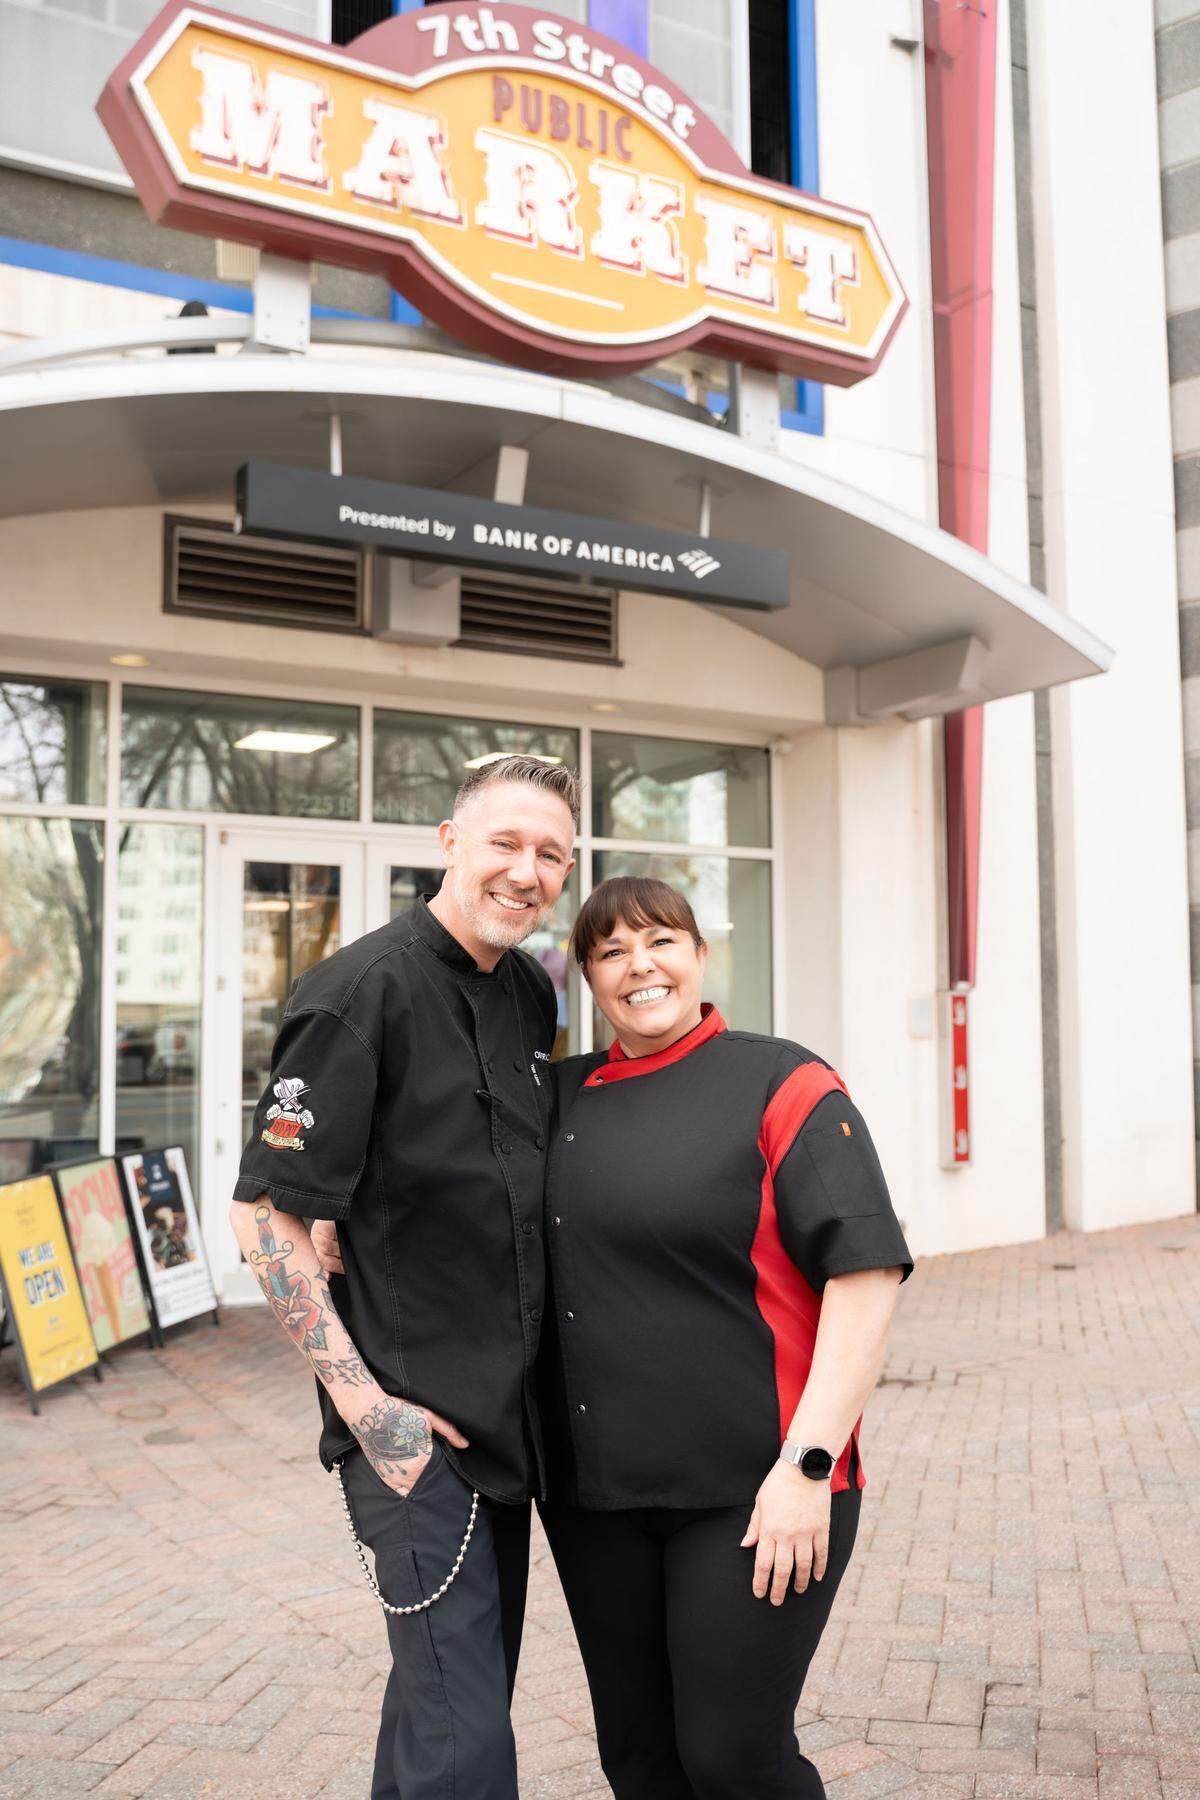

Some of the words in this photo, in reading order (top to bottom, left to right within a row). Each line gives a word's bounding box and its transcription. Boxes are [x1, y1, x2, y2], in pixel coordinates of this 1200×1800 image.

[416, 8, 520, 57] 7th
[532, 20, 697, 139] Street
[492, 75, 633, 161] PUBLIC
[191, 46, 859, 331] MARKET
[339, 505, 429, 534] Presented
[433, 520, 456, 541] by
[473, 524, 538, 551] BANK
[542, 535, 573, 556] OF
[576, 541, 675, 573] AMERICA
[17, 1248, 35, 1268] WE
[37, 1241, 55, 1263] ARE
[24, 1267, 66, 1306] OPEN
